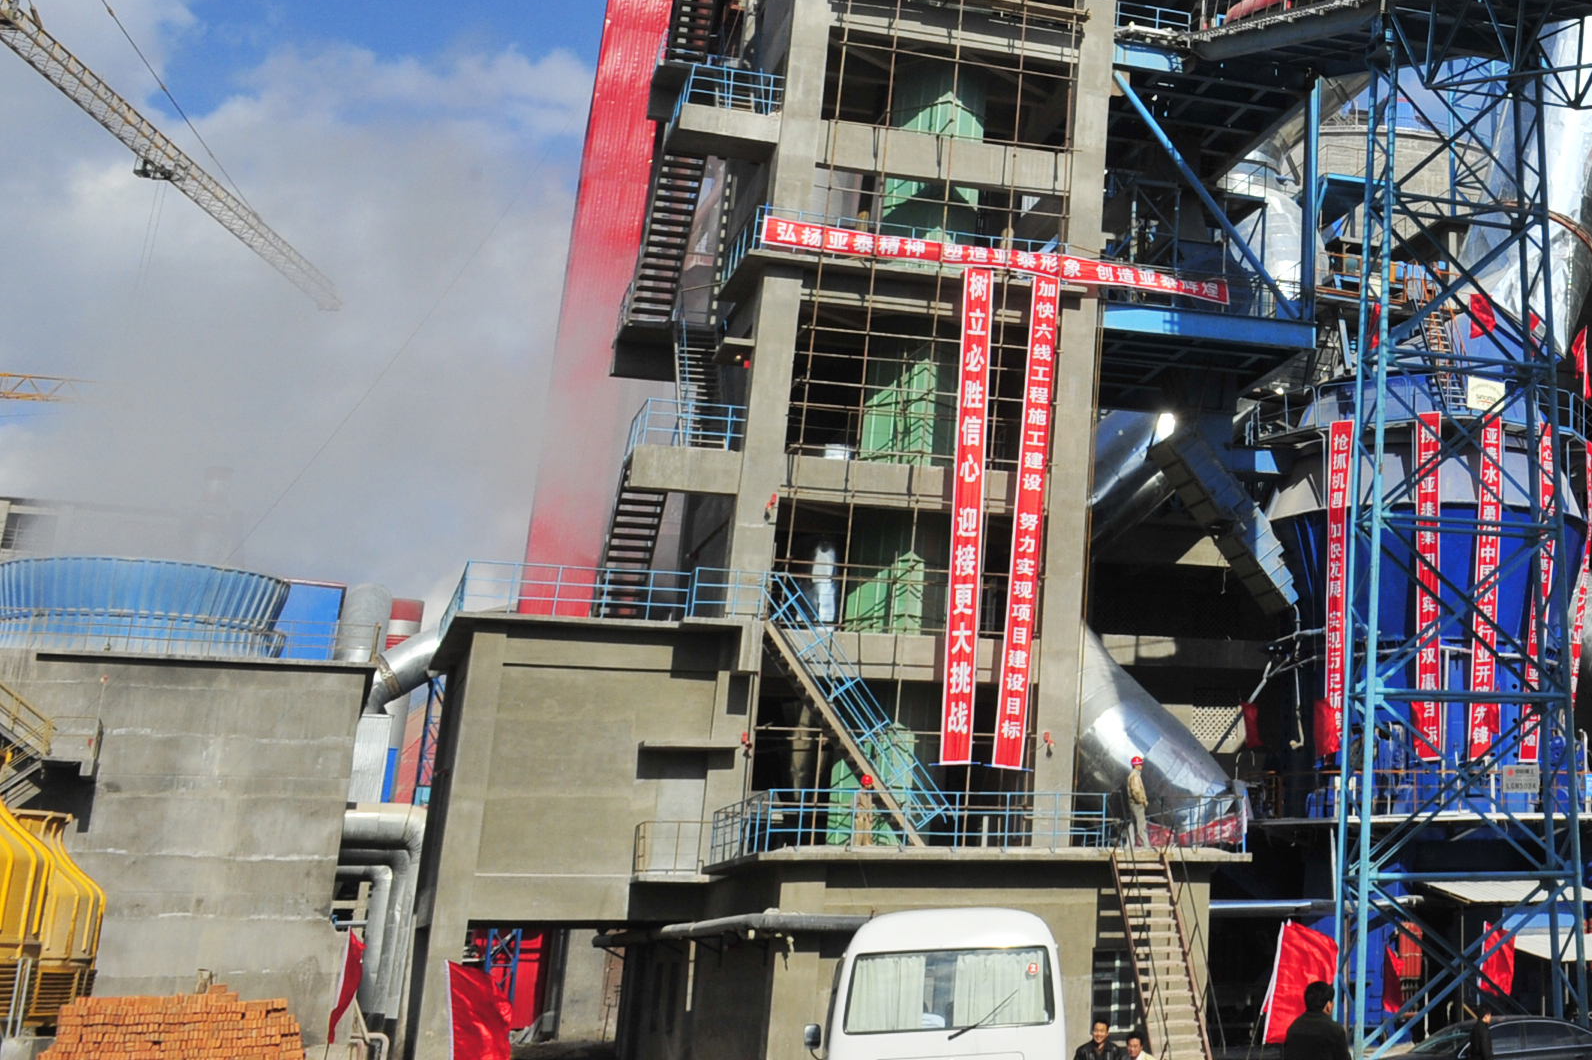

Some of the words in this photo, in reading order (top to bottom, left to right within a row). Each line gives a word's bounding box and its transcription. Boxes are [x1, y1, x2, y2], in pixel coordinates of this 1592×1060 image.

[776, 221, 926, 258] 弘扬亚泰精神
[943, 244, 1082, 278] 塑造亚泰形象
[960, 272, 988, 483] 树立必胜信心
[1022, 280, 1056, 491] 加快六线工程施工建设
[1331, 433, 1349, 509] 抢抓机遇
[948, 507, 977, 735] 迎接更大挑战
[1001, 512, 1038, 740] 努力实现项目建设目标
